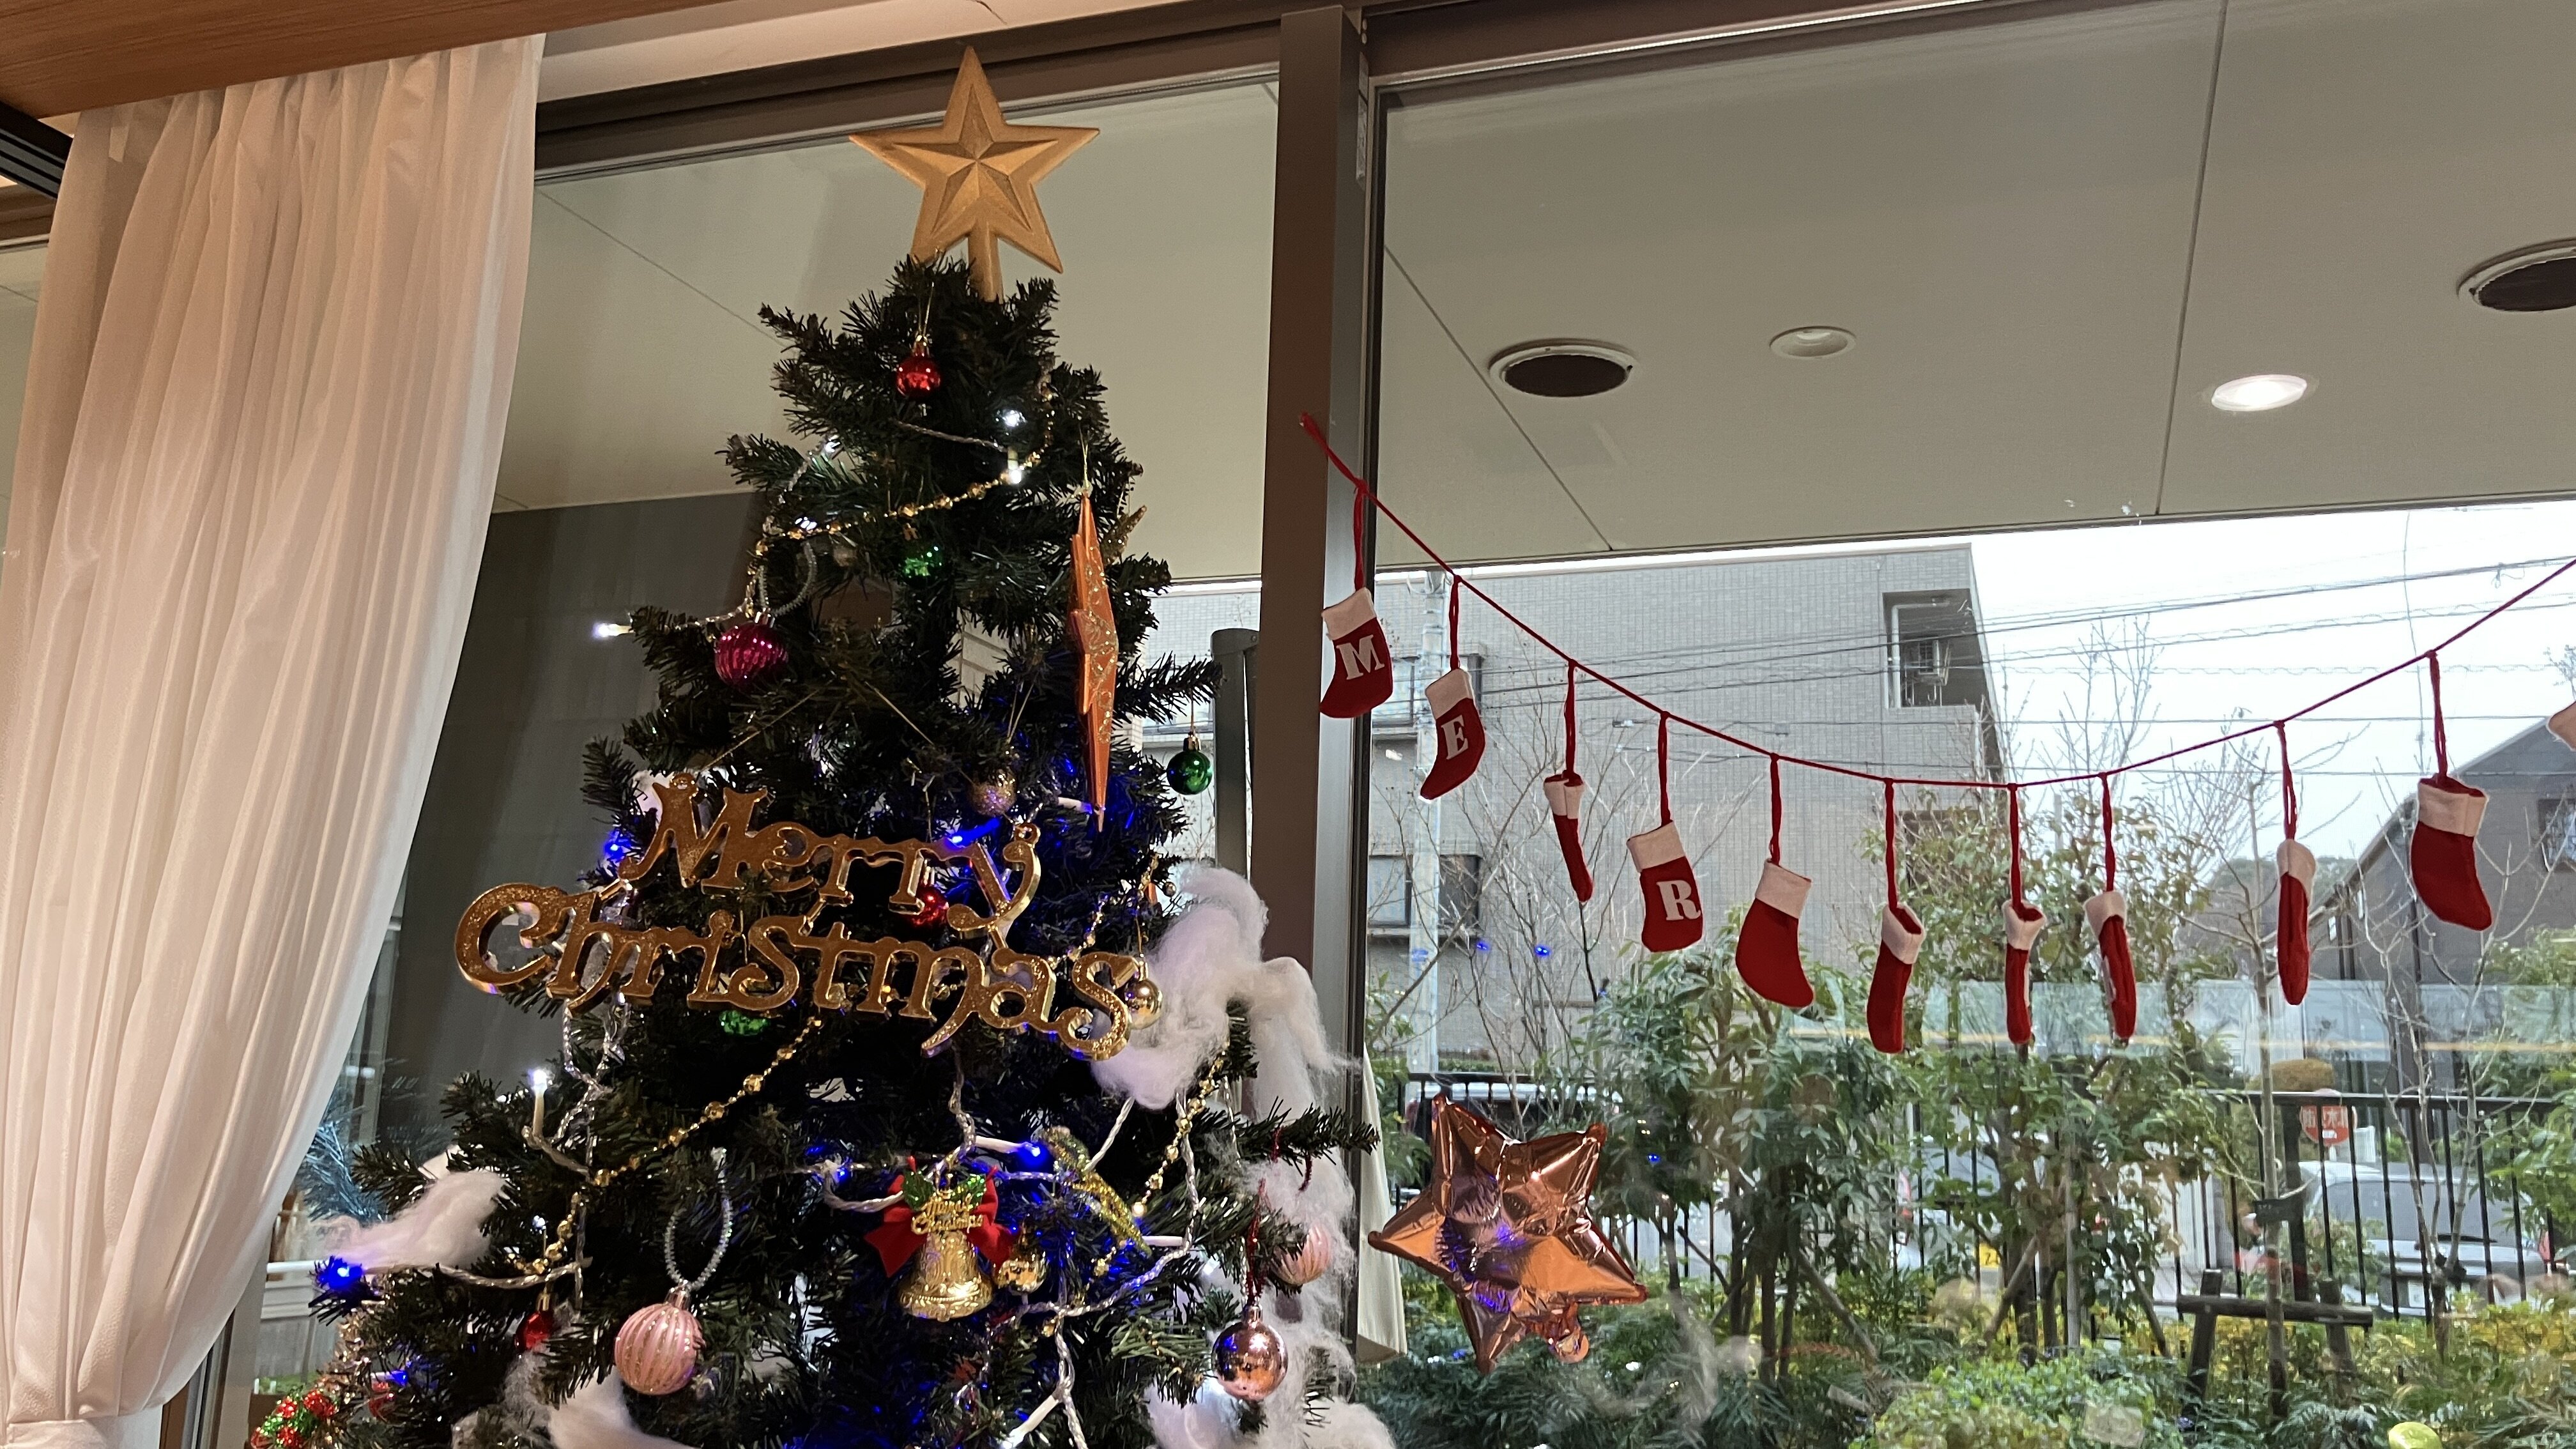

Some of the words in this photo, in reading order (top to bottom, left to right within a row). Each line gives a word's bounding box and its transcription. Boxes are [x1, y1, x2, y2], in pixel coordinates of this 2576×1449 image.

[618, 773, 1041, 935] Merry
[1336, 634, 1385, 680] M
[1441, 715, 1469, 760] E
[1656, 879, 1702, 921] R
[454, 883, 1134, 1061] Christmas
